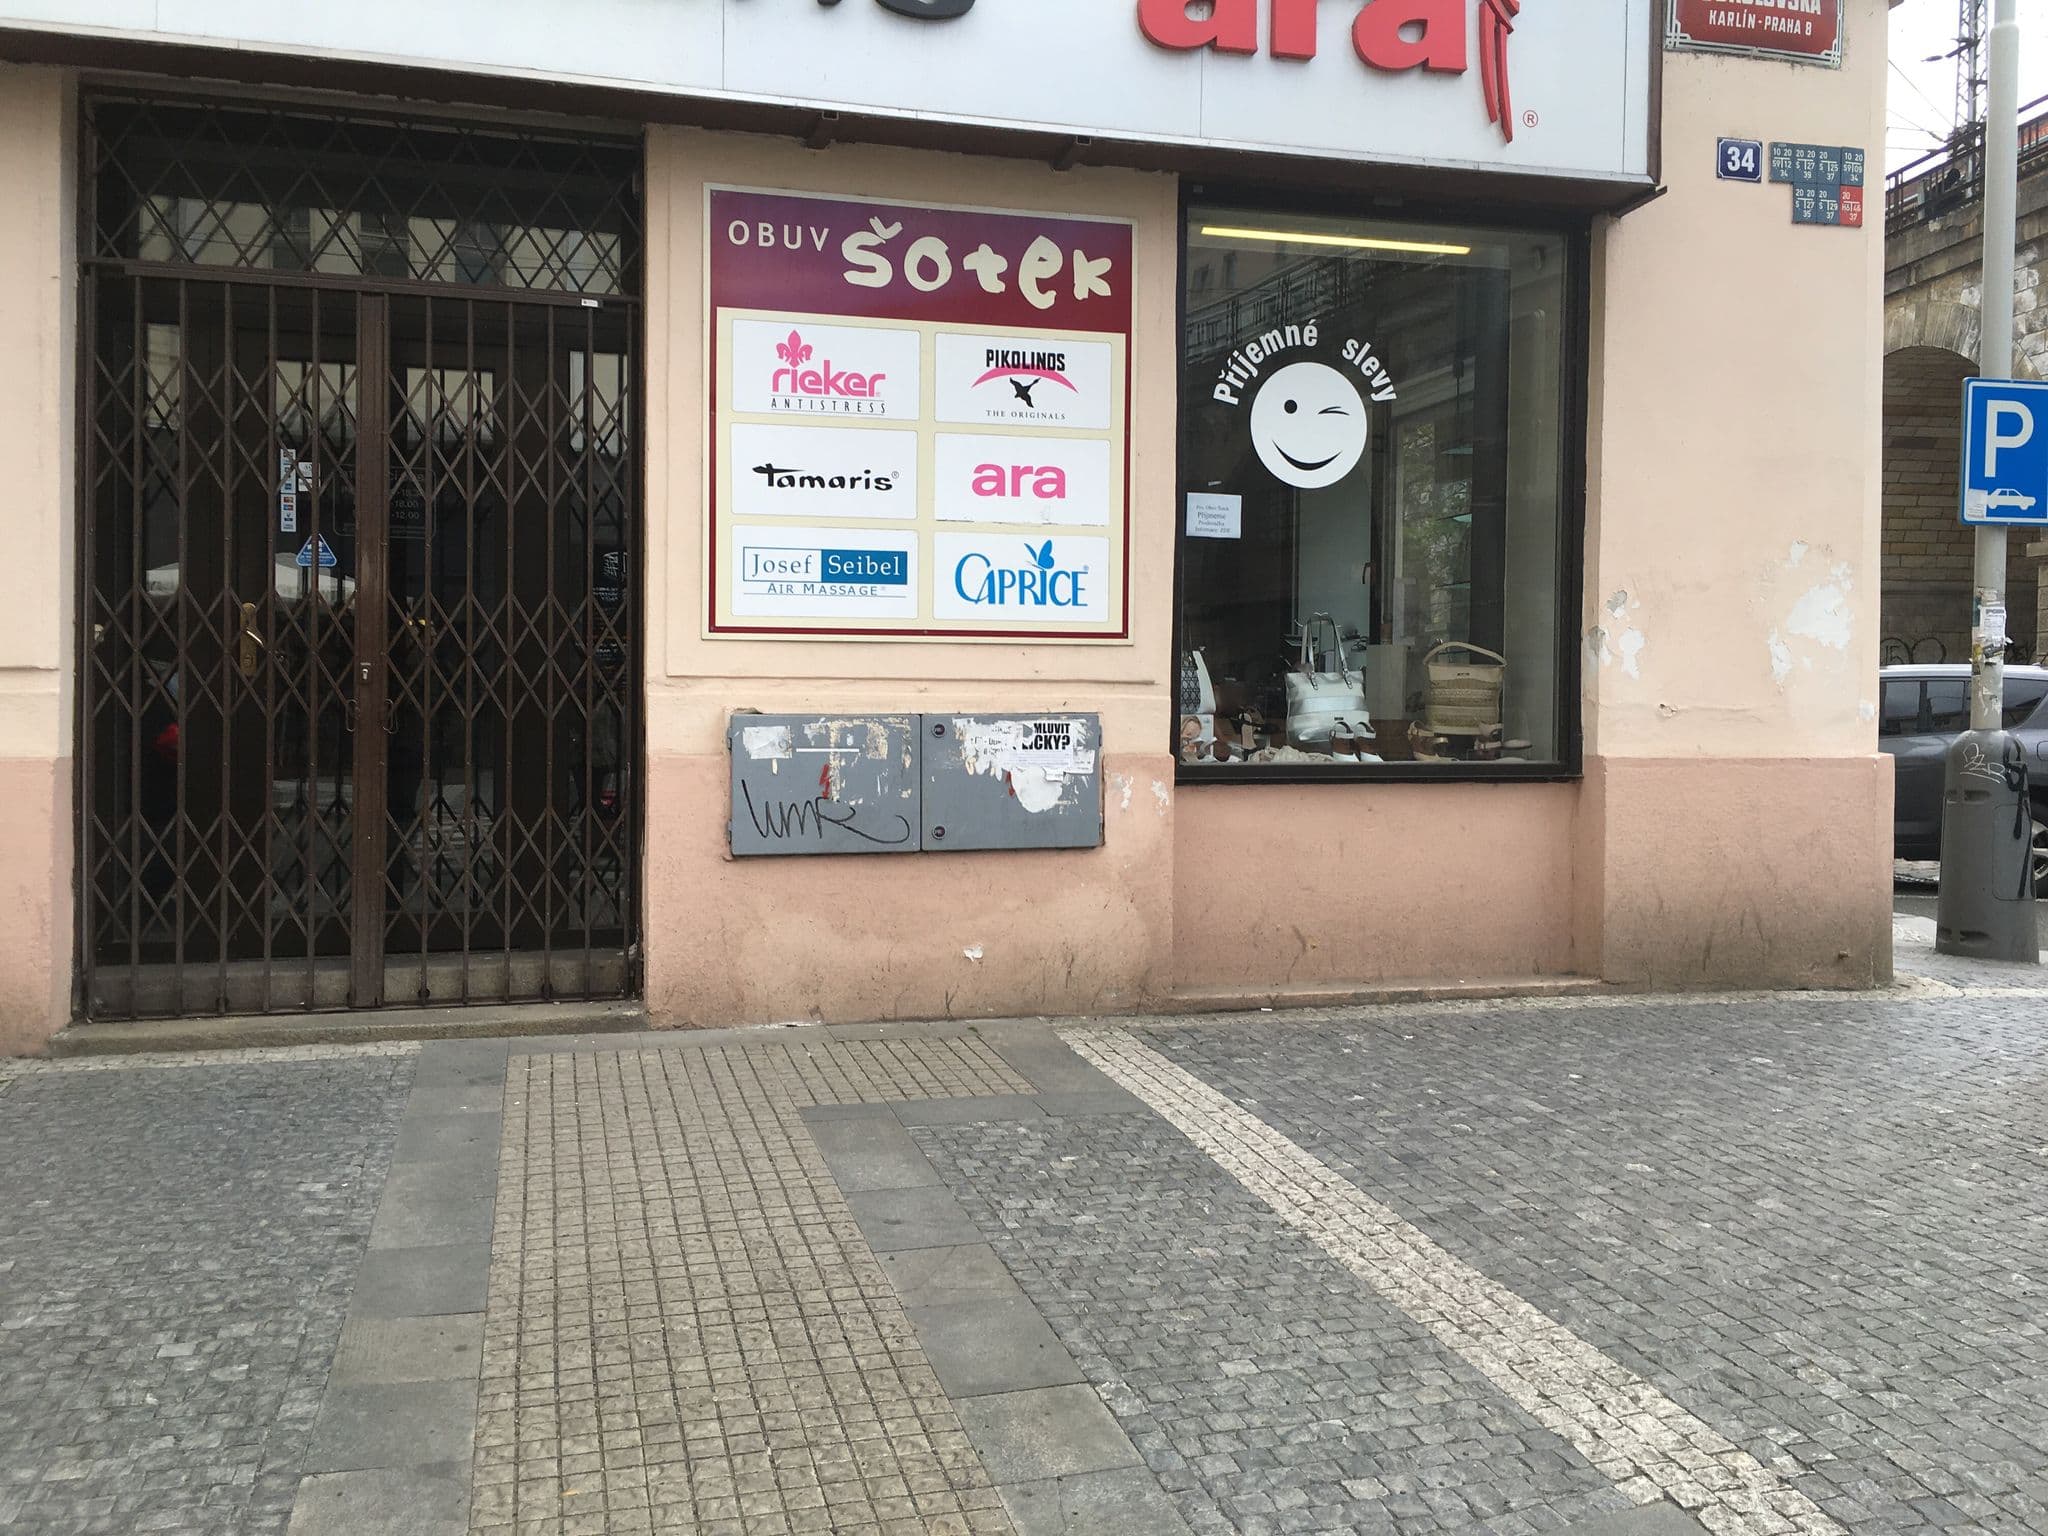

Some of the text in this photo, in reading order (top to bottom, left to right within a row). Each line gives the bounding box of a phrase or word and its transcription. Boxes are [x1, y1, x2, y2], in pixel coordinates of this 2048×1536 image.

[1709, 9, 1756, 29] KARLÍN
[1764, 15, 1801, 35] PRAHA
[1804, 21, 1812, 36] 8
[1727, 147, 1755, 172] 34
[728, 216, 1112, 310] OBUV Šotek
[986, 348, 1065, 372] PIKOLINOS
[1213, 319, 1397, 405] Příjemné slevy
[772, 359, 886, 397] rieker
[771, 397, 886, 414] ANTISTRESS
[986, 409, 1066, 420] THE ORIGINALS
[1984, 399, 2034, 478] P
[972, 463, 1066, 499] ara
[752, 553, 901, 577] Josef Seibel
[767, 582, 878, 598] AIR MASSAGE
